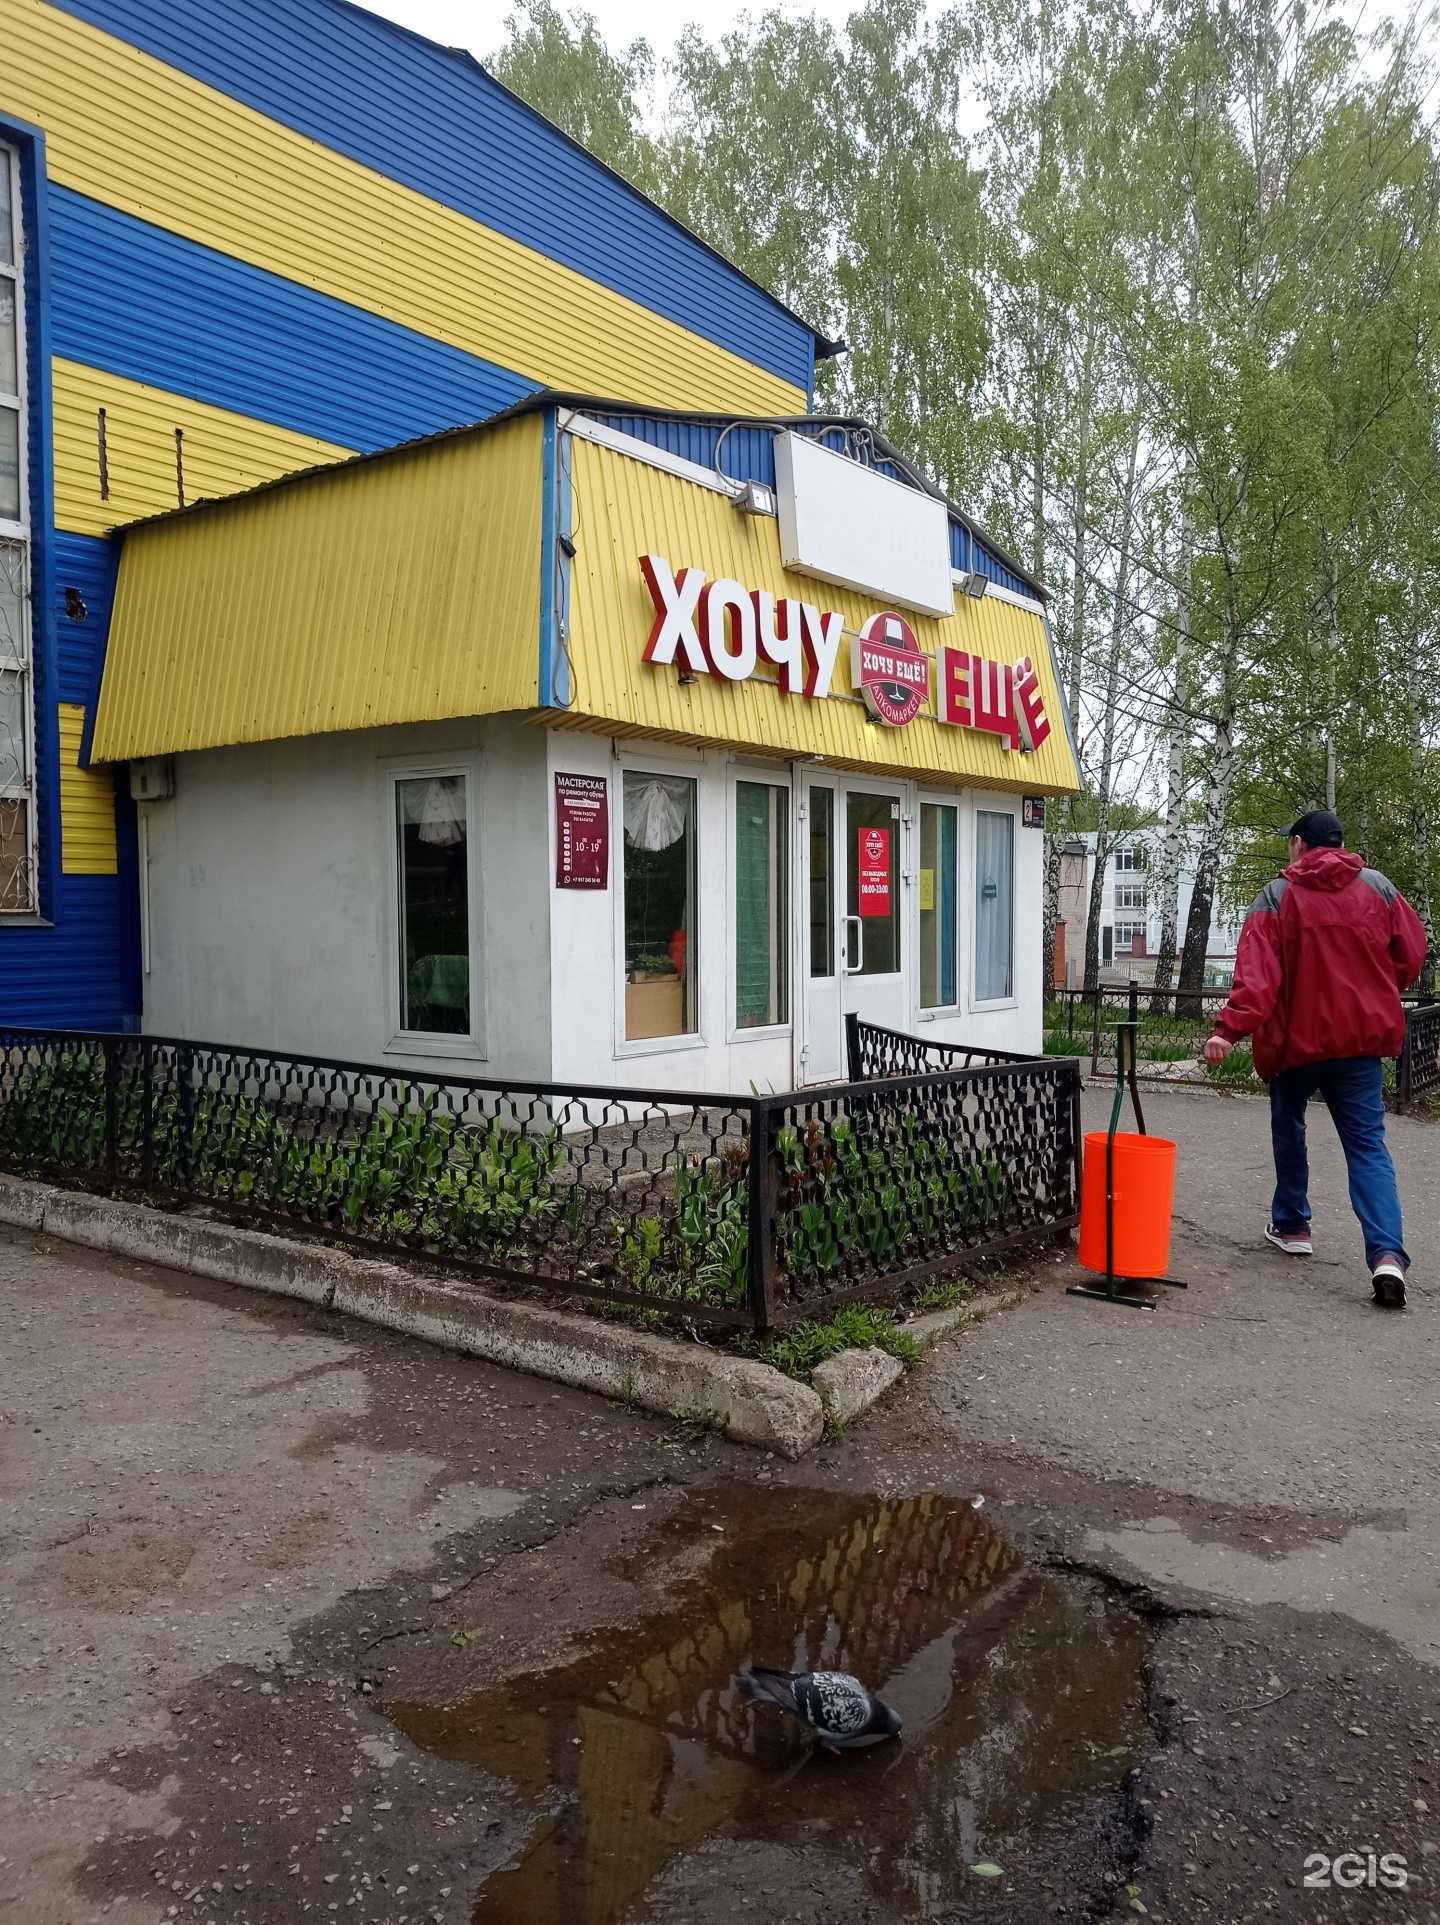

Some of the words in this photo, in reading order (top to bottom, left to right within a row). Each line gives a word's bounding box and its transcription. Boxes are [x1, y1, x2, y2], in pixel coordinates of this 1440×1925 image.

[641, 554, 844, 699] ХОЧУ
[937, 646, 1051, 752] ЕЩЁ
[863, 652, 893, 675] ХОЧУ
[896, 660, 926, 683] ЕЩЁ!
[873, 685, 918, 722] АЛКОМАРКЕТ
[557, 776, 604, 790] МАСТЕРСКАЯ
[576, 842, 585, 852] 10
[591, 843, 599, 852] 19
